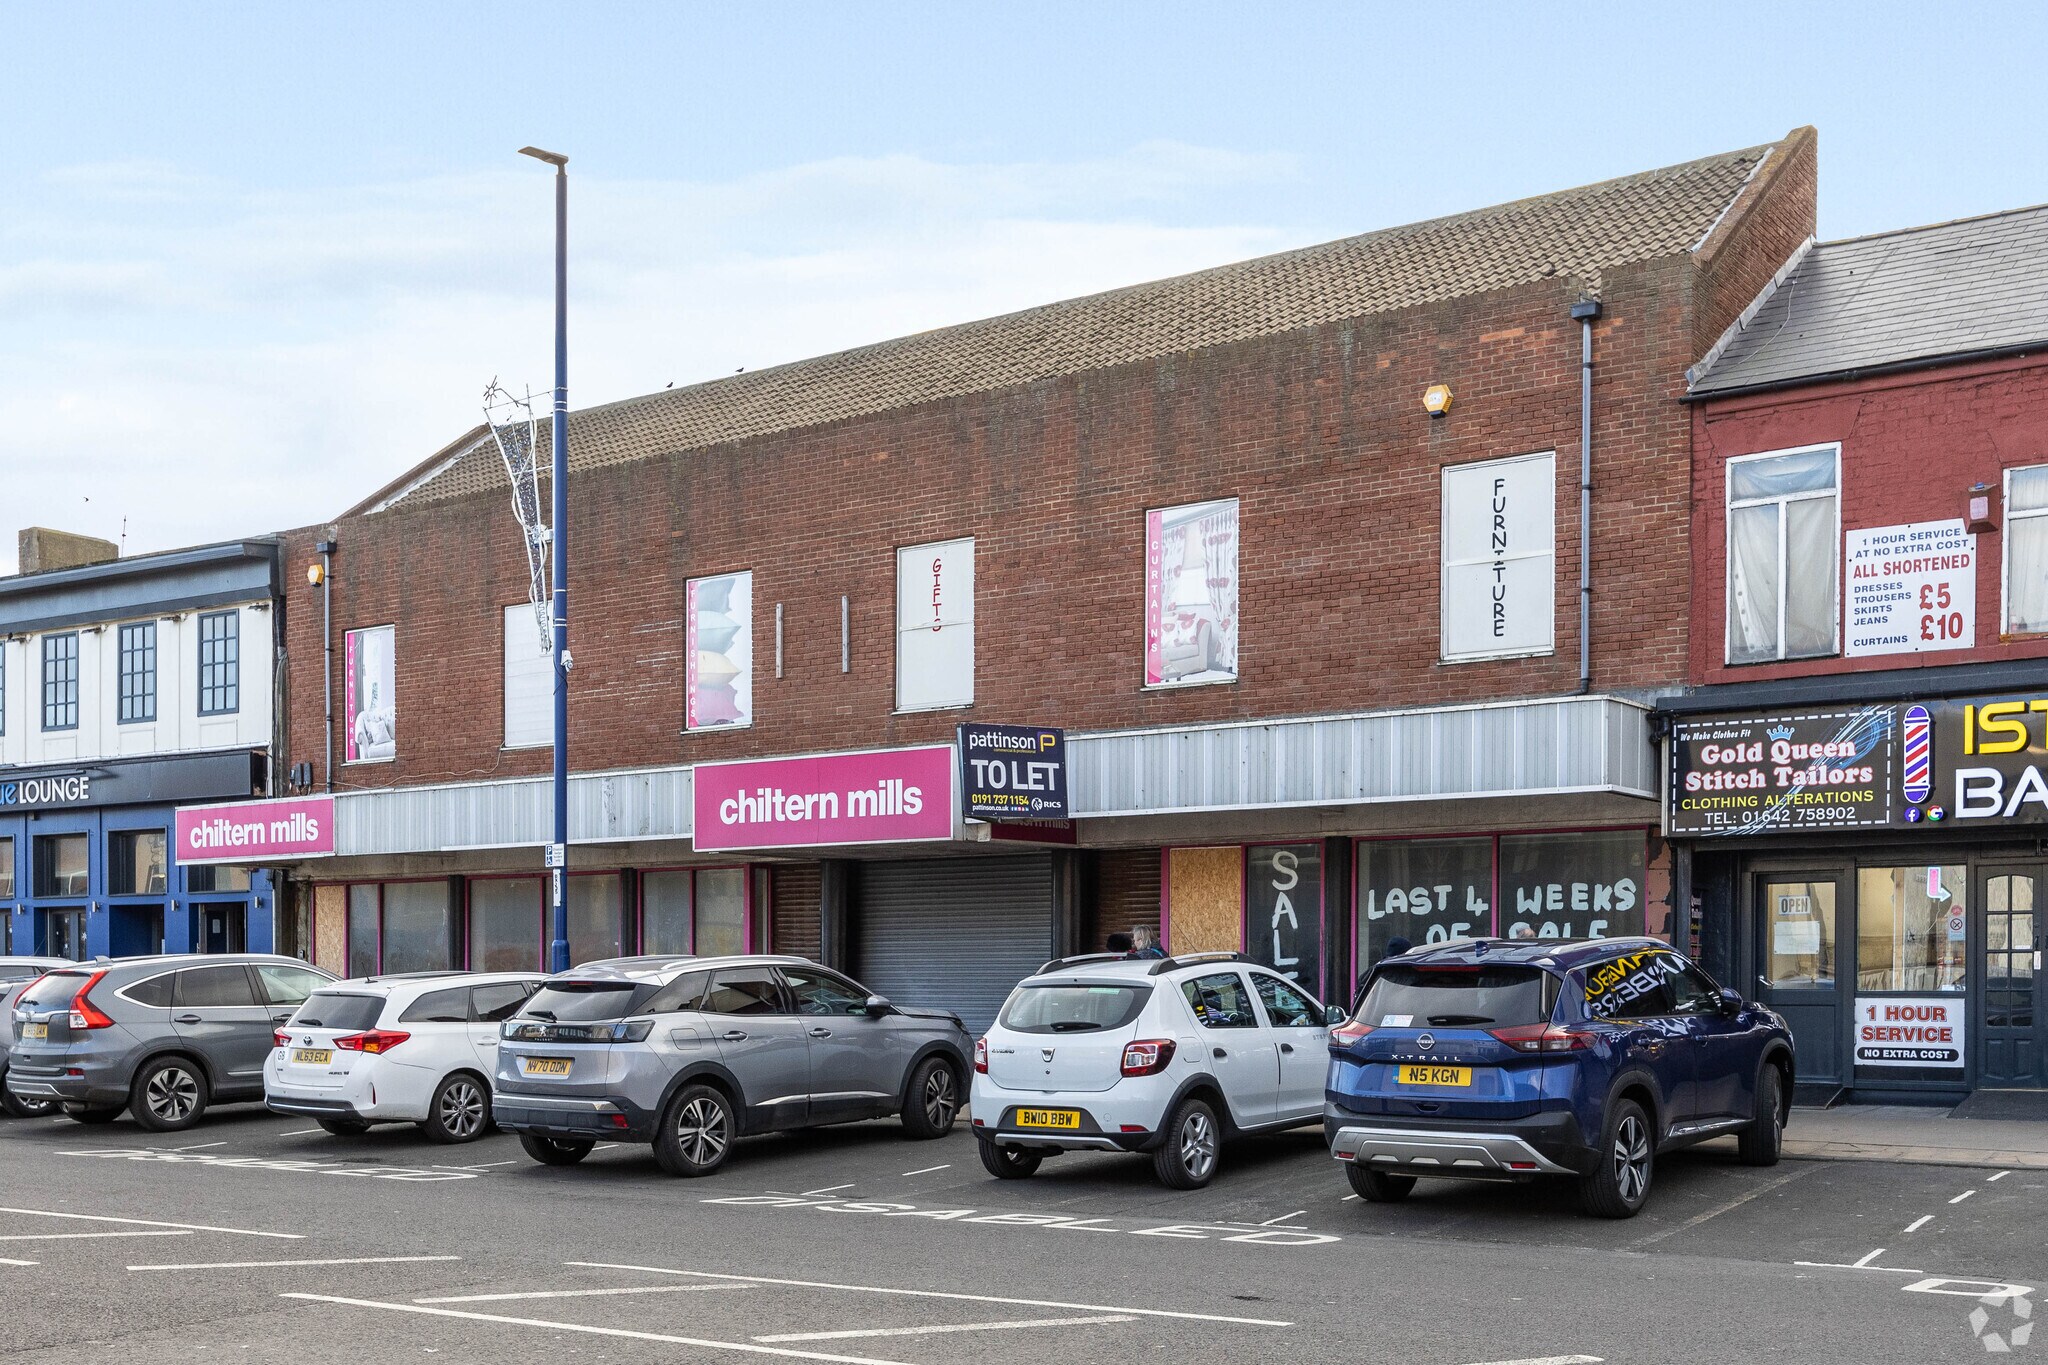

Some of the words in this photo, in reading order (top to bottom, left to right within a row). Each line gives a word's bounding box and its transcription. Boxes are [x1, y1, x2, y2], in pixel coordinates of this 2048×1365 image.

[1862, 538, 1867, 546] 1
[1872, 534, 1906, 545] HOUR
[1909, 527, 1961, 542] SERVICE
[1491, 478, 1507, 638] FURNITURE
[1855, 549, 1870, 559] AT
[1873, 547, 1890, 556] NO
[1894, 543, 1932, 555] EXTRA
[1936, 539, 1969, 550] COST
[1853, 564, 1879, 579] ALL
[1883, 554, 1970, 576] SHORTENED
[932, 558, 942, 633] GIFTS
[1150, 540, 1159, 653] CURTAINS
[1854, 581, 1903, 594] DRESSES
[1919, 582, 1951, 610] £5
[1854, 592, 1912, 604] TROUSERS
[1854, 604, 1893, 615] SKIRTS
[1854, 616, 1889, 626] JEANS
[1920, 612, 1964, 641] £10
[1853, 635, 1908, 647] CURTAINS
[969, 731, 1036, 750] pattinson
[1680, 732, 1691, 741] We
[1693, 731, 1711, 741] Make
[1712, 730, 1738, 740] Clothes
[1740, 728, 1751, 738] Fit
[1700, 741, 1763, 765] Gold
[1770, 740, 1856, 765] Queen
[970, 759, 1006, 789] TO
[1011, 760, 1060, 791] LET
[1685, 768, 1767, 791] Stitch
[1773, 764, 1874, 787] Tailors
[19, 776, 90, 804] LOUNGE
[971, 793, 991, 804] 0191
[992, 794, 1008, 804] 737
[1009, 795, 1029, 805] 1154
[719, 787, 838, 825] chiltern
[847, 778, 923, 818] mills
[1043, 800, 1062, 808] RICS
[1682, 795, 1758, 810] CLOTHING
[1764, 790, 1874, 807] ALTERATIONS
[1705, 812, 1737, 825] TEL:
[1742, 809, 1790, 823] 01642
[1796, 806, 1856, 821] 758902
[190, 817, 265, 849] chiltern
[270, 813, 319, 844] mills
[1368, 884, 1452, 920] LAST
[1466, 885, 1489, 916] 4
[1516, 878, 1637, 916] WEEKS
[1781, 898, 1808, 913] OPEN
[1271, 851, 1300, 981] SAL
[1866, 1005, 1877, 1022] 1
[1884, 1004, 1947, 1022] HOUR
[1861, 1025, 1953, 1044] SERVICE
[295, 1051, 314, 1062] NL63
[1391, 1053, 1462, 1062] X-TRAIL
[1864, 1049, 1880, 1058] NO
[1882, 1049, 1917, 1059] EXTRA
[1920, 1049, 1950, 1059] COST
[1409, 1067, 1428, 1082] N5
[1432, 1068, 1460, 1083] KGN
[1023, 1111, 1048, 1126] BW10
[1050, 1111, 1073, 1126] BBW
[700, 1195, 1343, 1246] DISABLED
